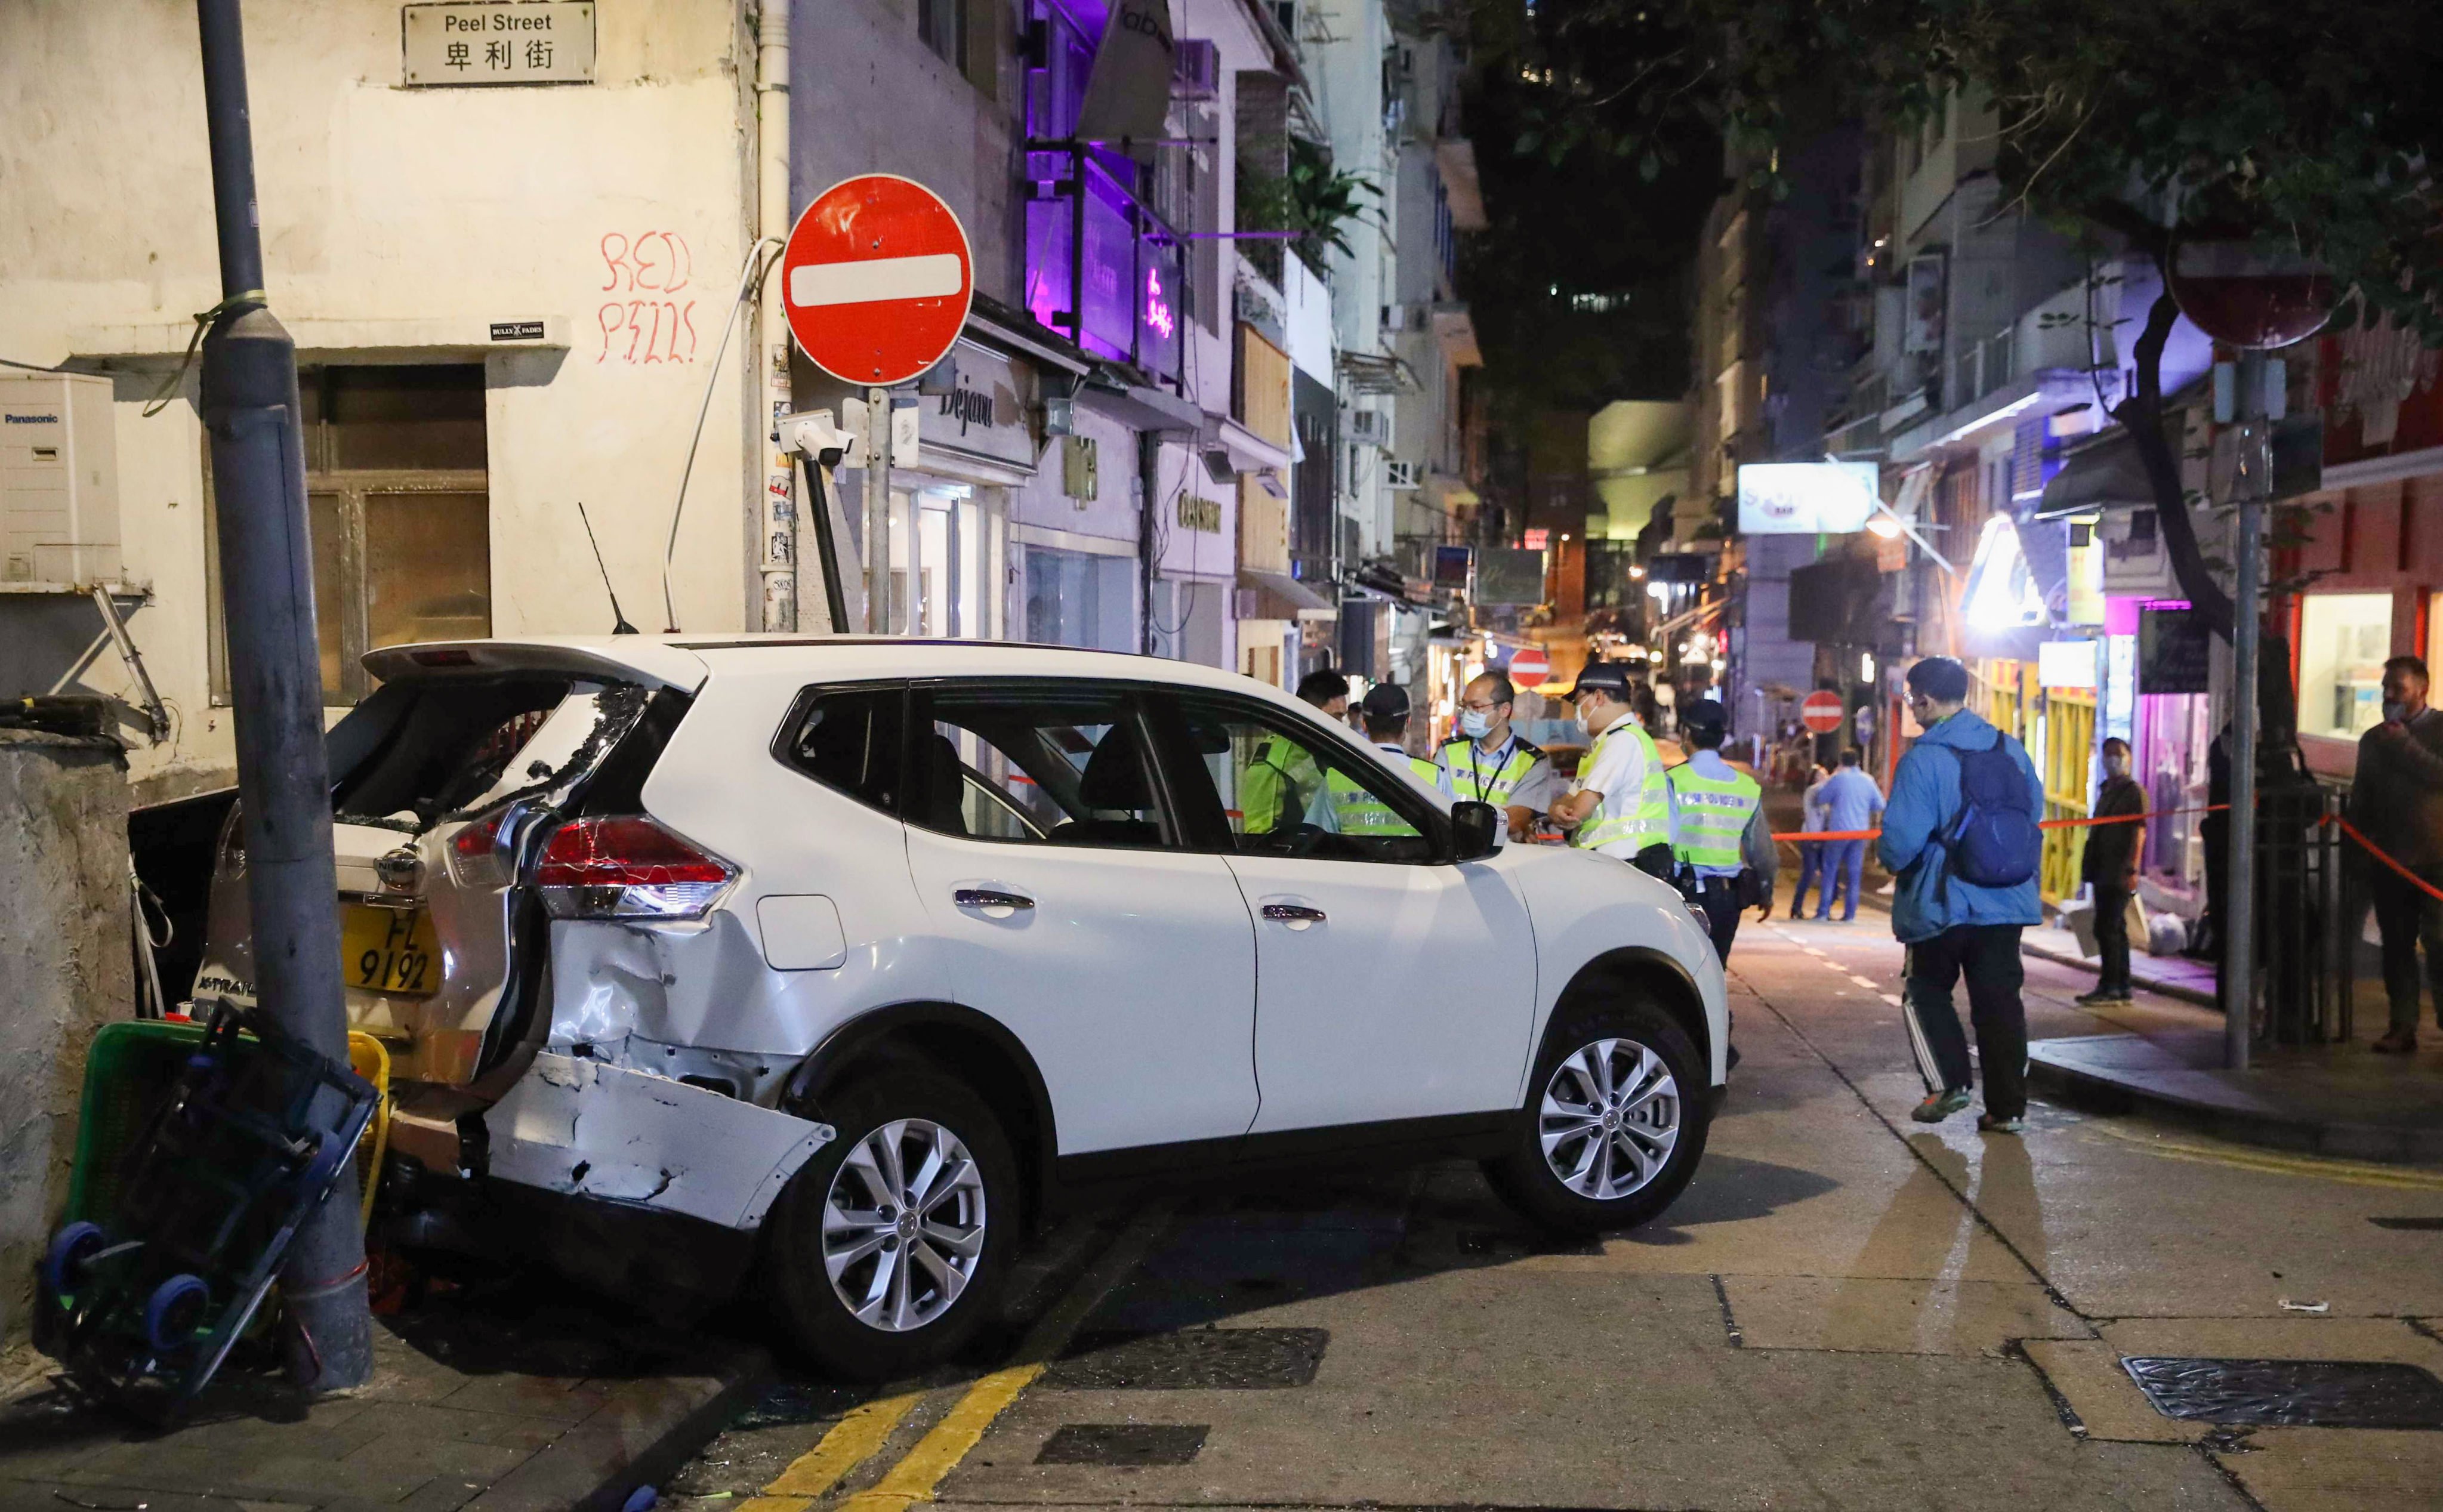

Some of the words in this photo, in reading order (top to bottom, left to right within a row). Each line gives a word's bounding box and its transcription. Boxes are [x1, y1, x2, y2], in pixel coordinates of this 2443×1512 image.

[445, 14, 486, 32] Peel
[493, 14, 552, 31] Street
[445, 39, 554, 72] 卑利街
[601, 230, 691, 294] RED
[5, 414, 58, 424] Panasonic
[360, 949, 428, 989] 9192
